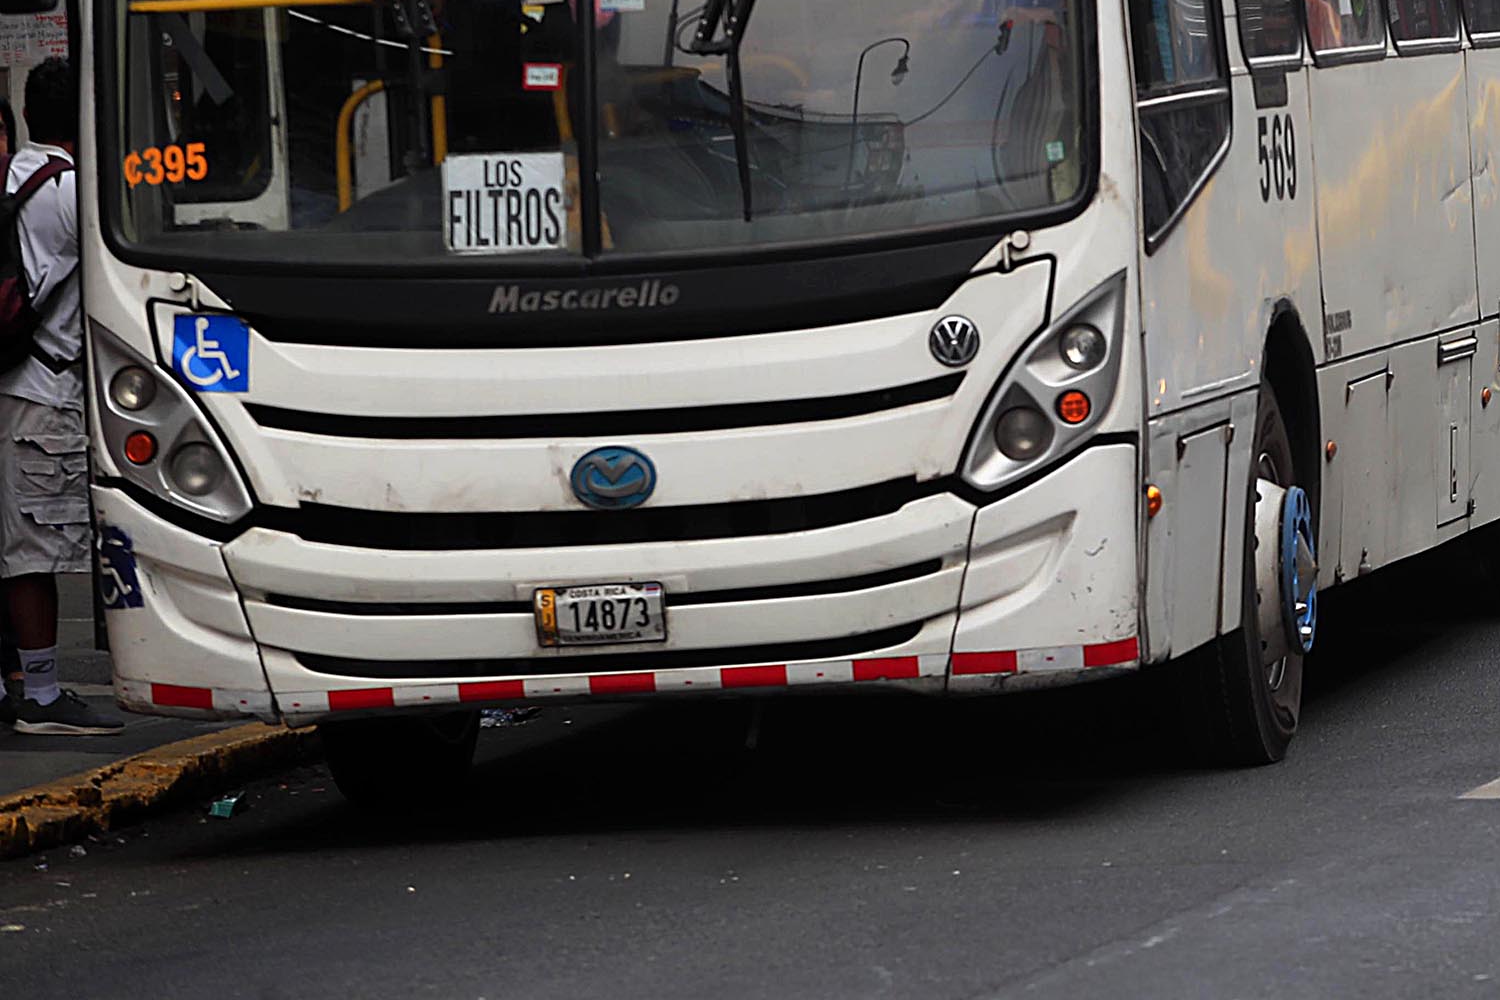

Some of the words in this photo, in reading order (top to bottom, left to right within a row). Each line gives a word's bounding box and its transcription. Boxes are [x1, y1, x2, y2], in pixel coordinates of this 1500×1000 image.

[483, 160, 523, 187] LOS
[1257, 113, 1297, 203] 569
[449, 188, 560, 248] FILTROS
[488, 279, 680, 314] Mascarello
[568, 597, 651, 633] 14873
